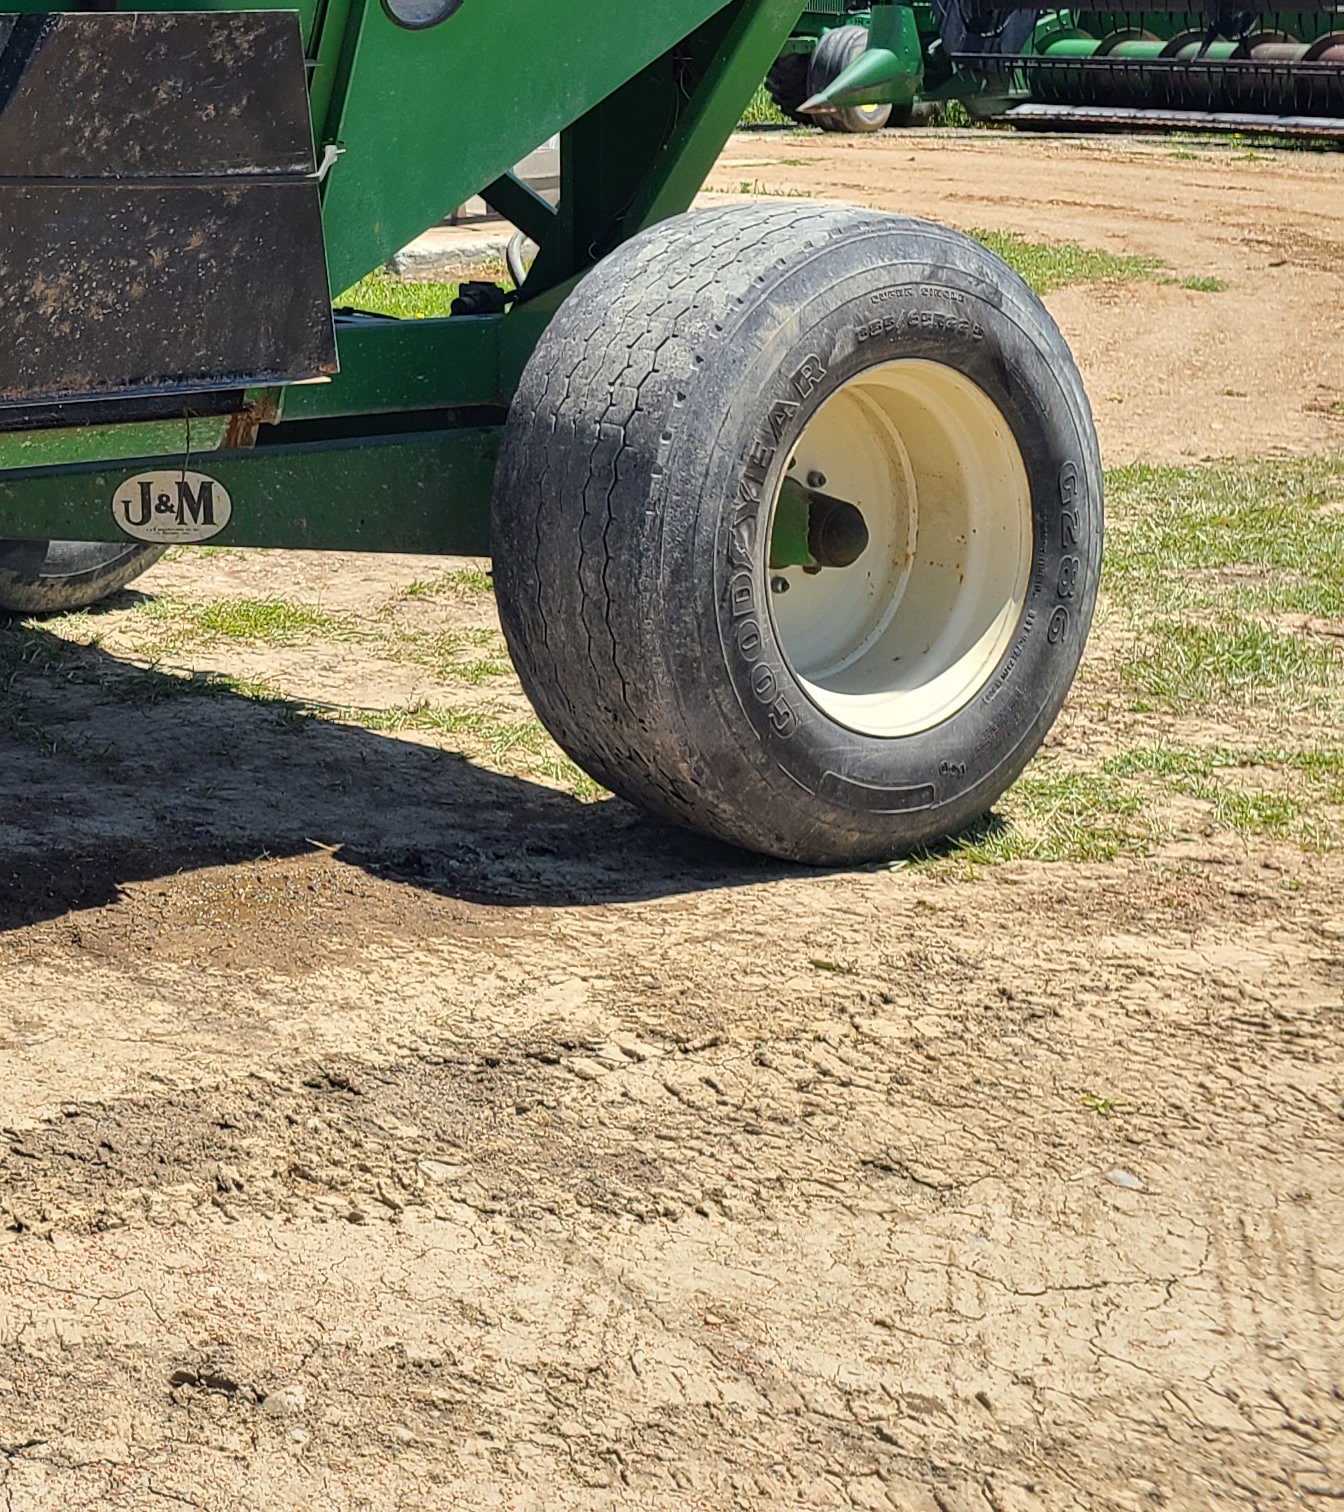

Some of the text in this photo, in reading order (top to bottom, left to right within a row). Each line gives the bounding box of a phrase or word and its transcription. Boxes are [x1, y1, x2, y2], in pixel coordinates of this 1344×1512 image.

[121, 481, 217, 526] J&M
[729, 353, 828, 738] GOODYEAR
[1046, 459, 1081, 646] G286
